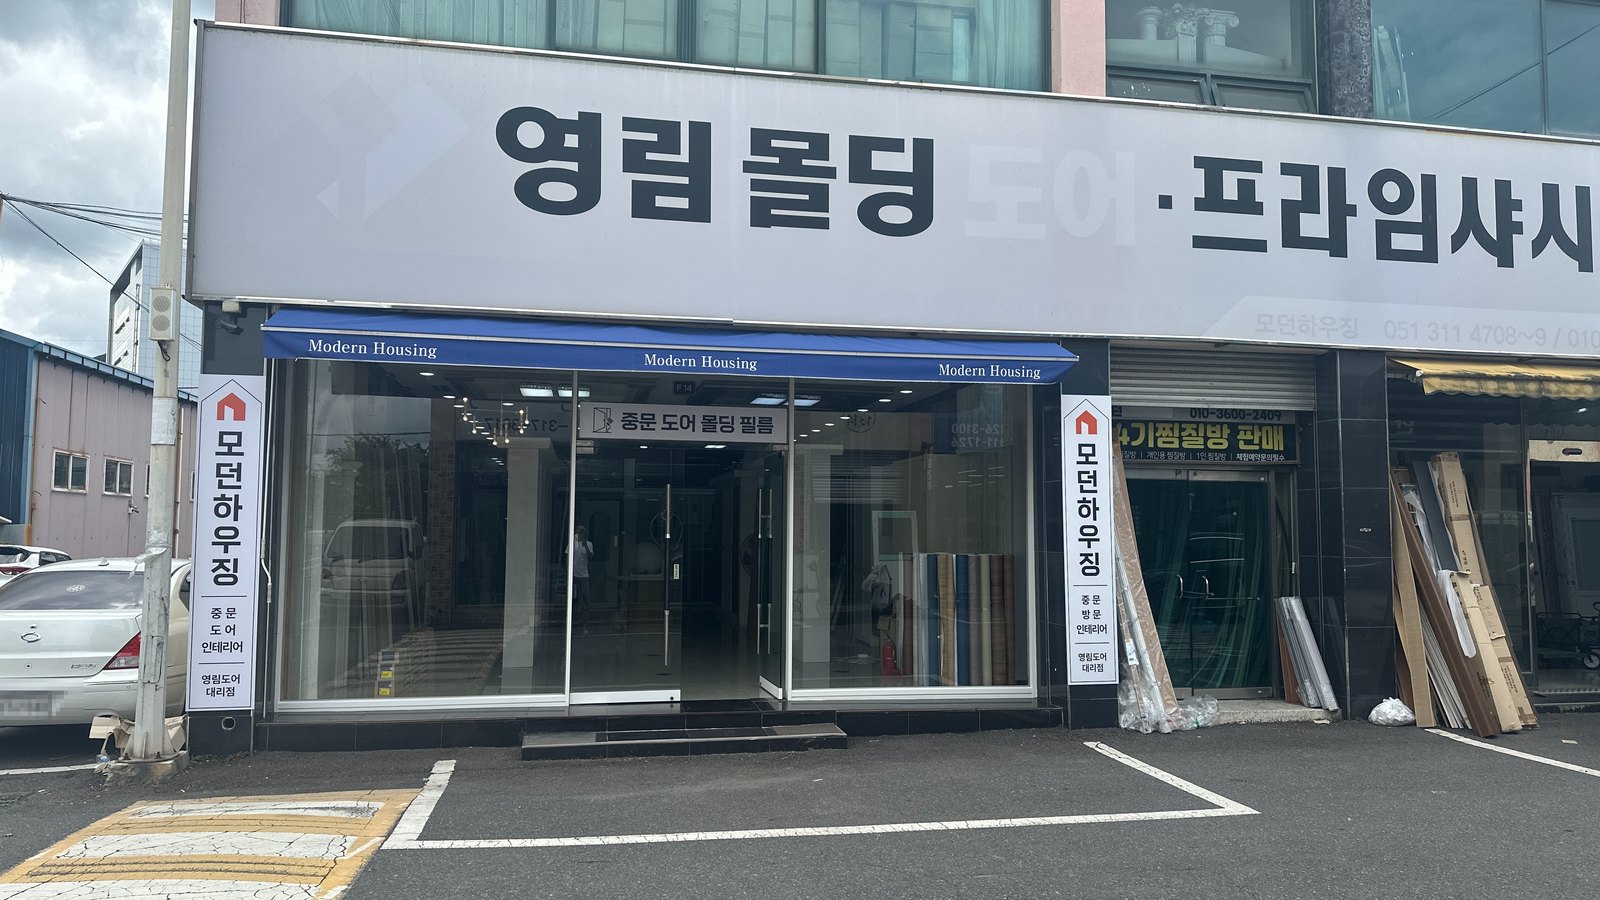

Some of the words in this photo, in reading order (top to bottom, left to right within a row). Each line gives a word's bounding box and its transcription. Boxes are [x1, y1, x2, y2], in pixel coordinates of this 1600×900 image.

[496, 106, 712, 224] 영림
[743, 127, 934, 238] 몰딩
[1255, 313, 1359, 340] 모던하우징
[1384, 319, 1418, 341] 051
[1427, 321, 1461, 343] 311
[308, 339, 367, 354] Modern
[373, 341, 438, 359] Housing
[644, 353, 697, 368] Modern
[701, 355, 758, 371] Housing
[939, 363, 986, 376] Modern
[990, 364, 1041, 379] Housing
[1189, 407, 1282, 422] 010-3600-2409
[620, 412, 657, 431] 중문
[661, 414, 696, 433] 도어
[700, 414, 735, 434] 몰딩
[739, 415, 774, 435] 필름
[1236, 424, 1285, 451] 판매
[1120, 450, 1137, 459] 질방
[1146, 451, 1166, 460] 개인용
[1167, 451, 1186, 460] 찜질방
[1208, 452, 1227, 460] 찜질방
[210, 431, 244, 586] 모던하우징
[1076, 443, 1101, 577] 모던하우징
[1076, 623, 1108, 635] 인테리어
[201, 640, 243, 654] 인테리어
[1077, 652, 1107, 663] 영림도어
[1081, 664, 1104, 673] 대리점
[201, 673, 241, 685] 영림도어
[205, 686, 235, 698] 대리점
